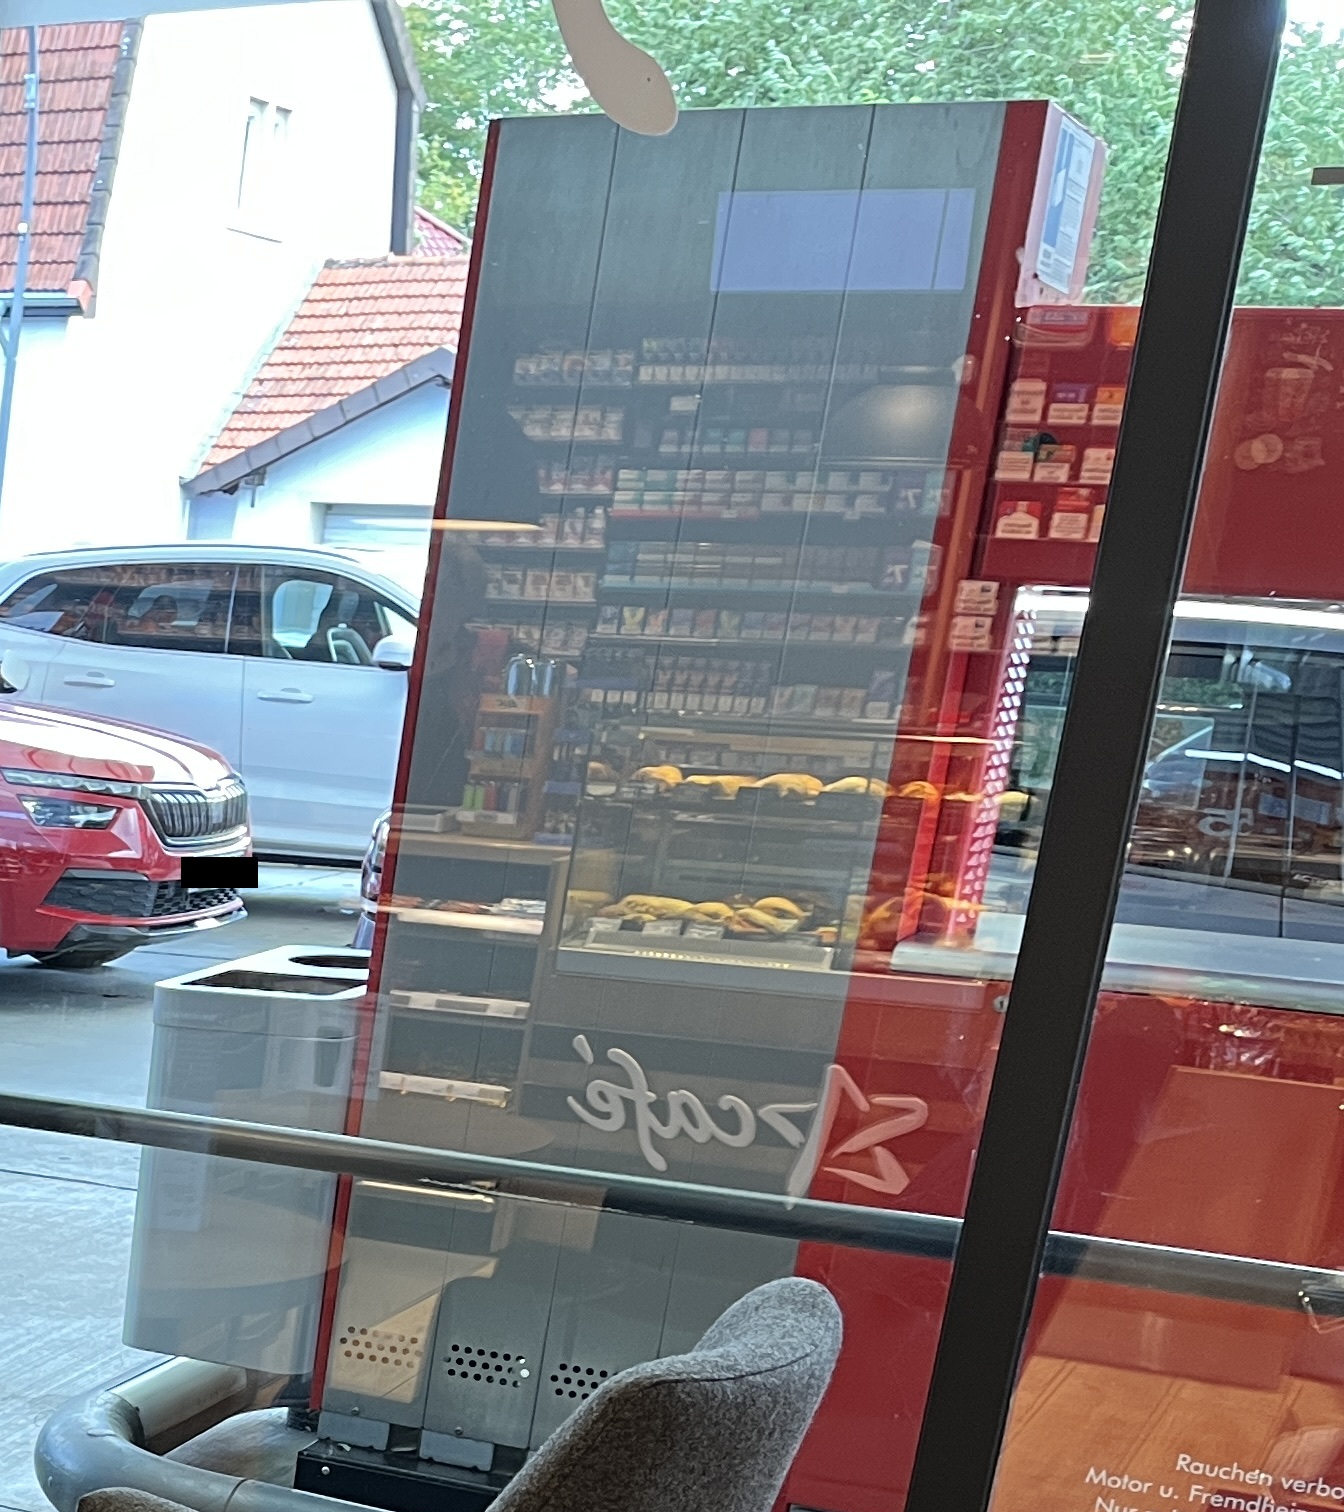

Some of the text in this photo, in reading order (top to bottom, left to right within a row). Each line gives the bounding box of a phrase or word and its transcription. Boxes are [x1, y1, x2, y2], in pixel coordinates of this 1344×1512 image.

[1085, 1466, 1153, 1494] Motor
[1159, 1485, 1179, 1500] u.
[1175, 1453, 1273, 1486] Rauchen
